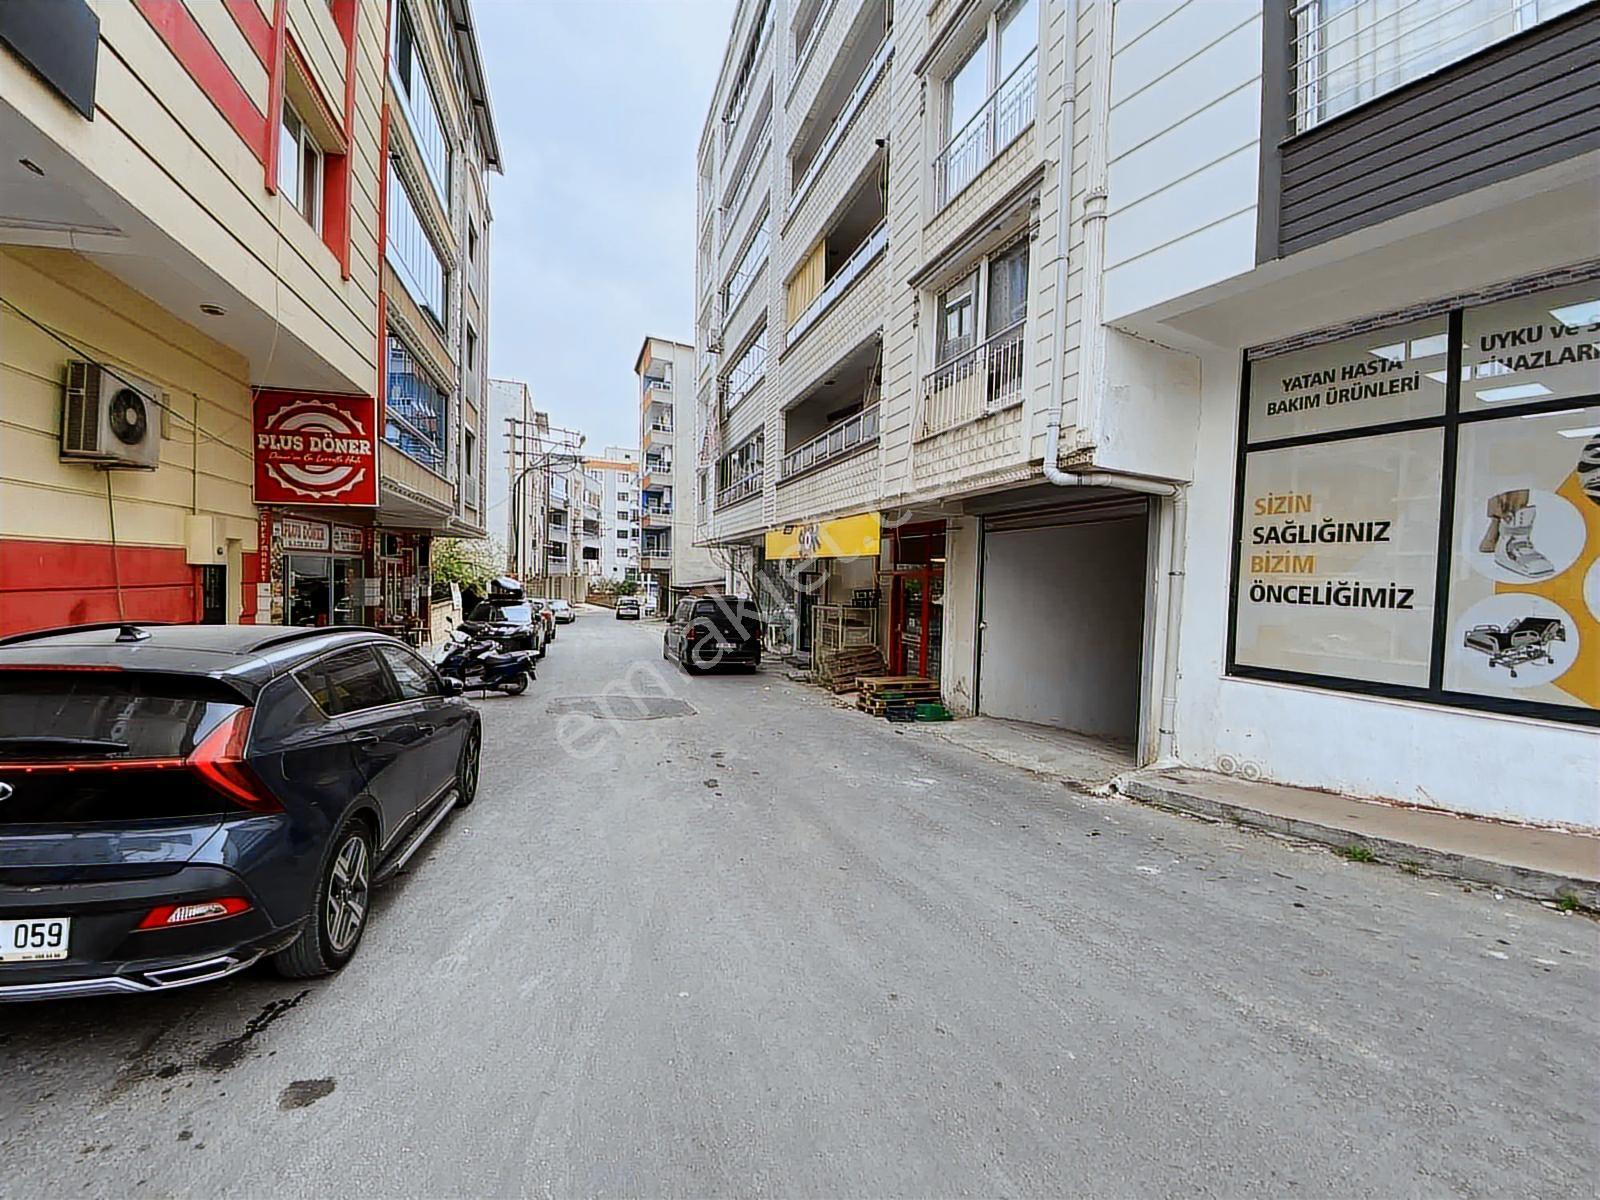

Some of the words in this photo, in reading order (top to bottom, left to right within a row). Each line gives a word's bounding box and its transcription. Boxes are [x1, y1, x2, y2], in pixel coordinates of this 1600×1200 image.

[1481, 325, 1543, 352] UYKU
[1550, 322, 1580, 339] ve
[1282, 369, 1336, 393] YATAN
[1341, 356, 1403, 380] HASTA
[1267, 393, 1320, 416] BAKIM
[1326, 371, 1420, 405] ÜRÜNLERİ
[257, 434, 304, 451] PLUS
[309, 433, 372, 455] DÖNER
[1254, 491, 1312, 516] SİZİN
[1252, 517, 1391, 545] SAĞLIĞINIZ
[1251, 550, 1315, 574] BİZİM
[1249, 579, 1415, 609] ÖNCELİĞİMİZ
[14, 923, 63, 948] 059
